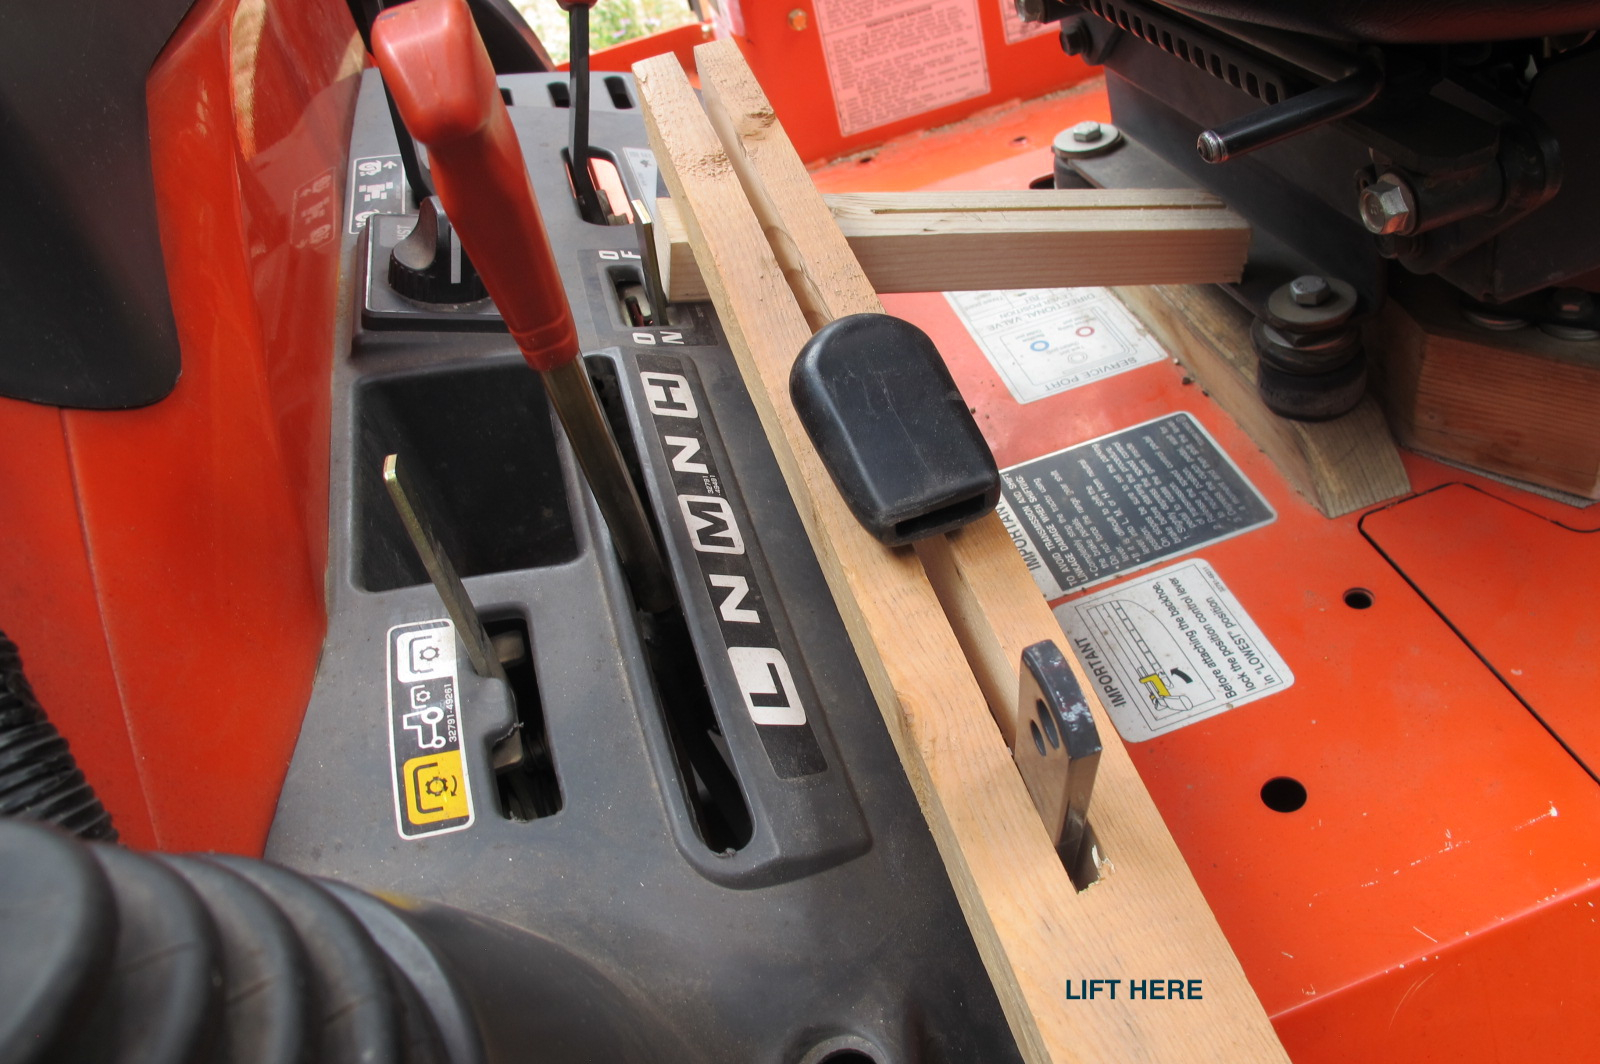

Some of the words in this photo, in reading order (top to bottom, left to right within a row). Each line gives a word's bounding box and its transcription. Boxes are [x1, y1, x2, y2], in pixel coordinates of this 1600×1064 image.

[1027, 292, 1096, 317] DIRECTIONAL
[988, 316, 1021, 330] VALVE
[1086, 356, 1137, 377] SERVICE
[1045, 375, 1079, 391] PORT
[648, 378, 688, 411] H
[664, 436, 708, 474] N
[1001, 473, 1016, 489] SHIFT
[1033, 477, 1046, 492] using
[1013, 490, 1026, 503] AND
[1043, 494, 1058, 512] tractor
[1033, 503, 1049, 522] WHEN
[1056, 513, 1066, 523] the
[1082, 514, 1092, 524] the
[690, 501, 736, 548] M
[1022, 505, 1054, 550] TRANSMISSION
[1063, 524, 1076, 537] stop
[1089, 526, 1102, 541] force
[1046, 523, 1068, 551] DAMAGE
[1135, 538, 1150, 554] lever
[1160, 536, 1170, 547] On
[1073, 539, 1098, 572] Completely
[1085, 538, 1100, 556] brake
[1099, 542, 1111, 553] not
[1051, 552, 1069, 572] AVOID
[1064, 552, 1088, 581] LINKAGE
[1098, 557, 1108, 568] the
[1109, 554, 1119, 565] Do
[1066, 575, 1077, 586] TO
[1168, 577, 1186, 596] lever
[708, 574, 760, 624] N
[1152, 581, 1179, 617] backhoe,
[1180, 595, 1206, 623] control
[1205, 596, 1236, 628] position
[1175, 616, 1189, 630] the
[1185, 629, 1216, 668] attaching
[1203, 623, 1233, 656] position
[1227, 631, 1264, 674] "LOWEST"
[1074, 638, 1125, 706] IMPORTANT
[1227, 657, 1241, 672] the
[749, 662, 790, 708] L
[1212, 669, 1236, 698] Before
[1237, 671, 1256, 691] lock
[1263, 674, 1275, 684] in
[444, 684, 457, 742] 32791-49261
